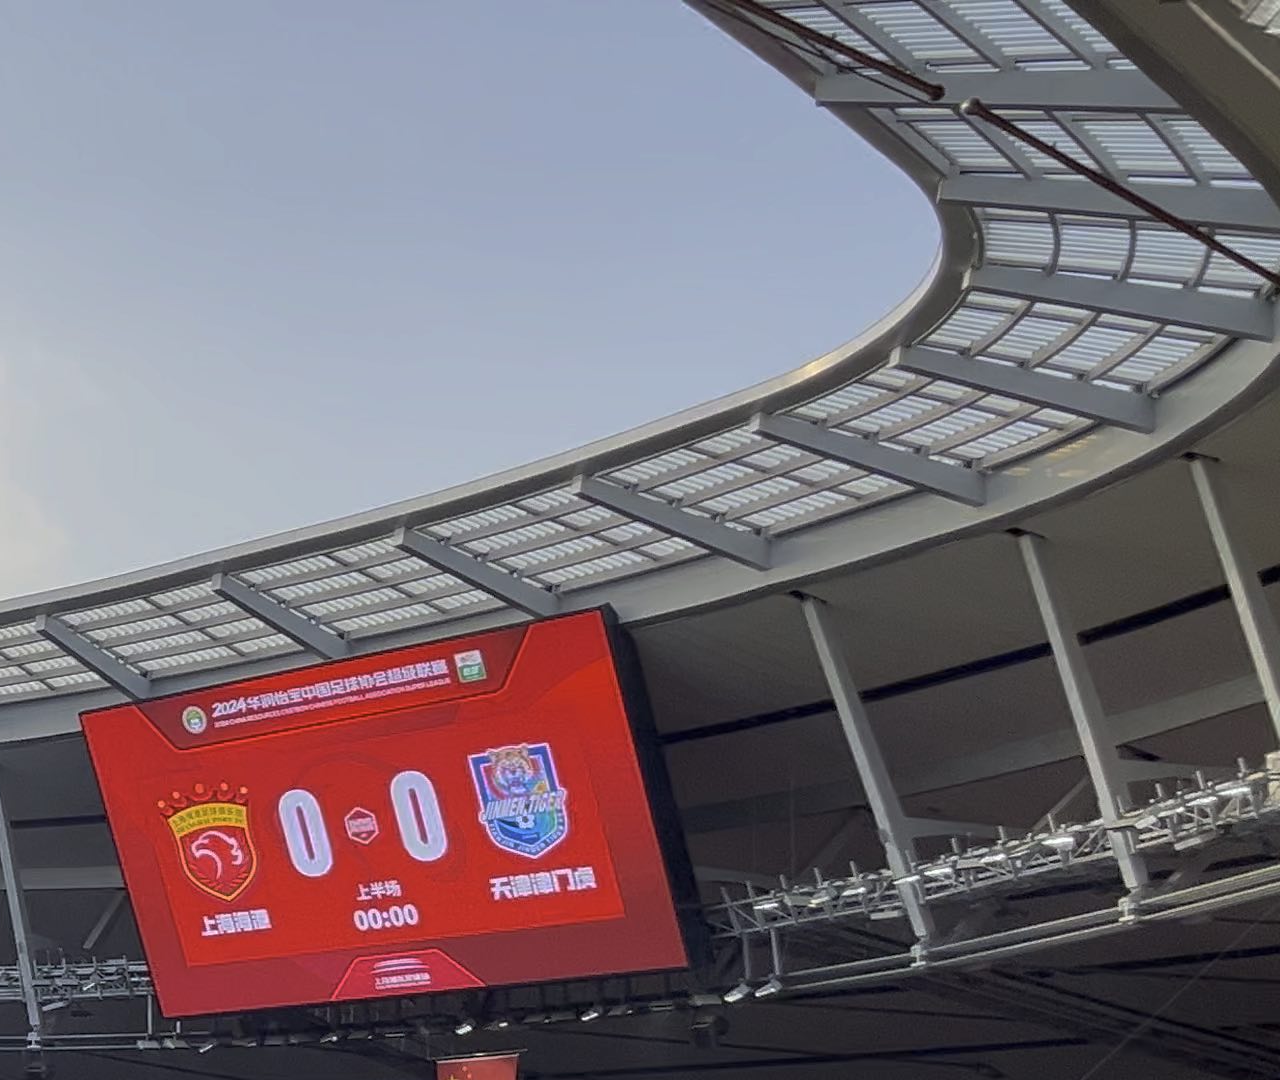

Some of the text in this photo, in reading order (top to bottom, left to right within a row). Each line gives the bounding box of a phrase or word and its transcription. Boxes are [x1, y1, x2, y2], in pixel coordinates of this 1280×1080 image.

[278, 788, 334, 878] 0
[390, 770, 450, 863] 0
[353, 903, 420, 932] 00:00
